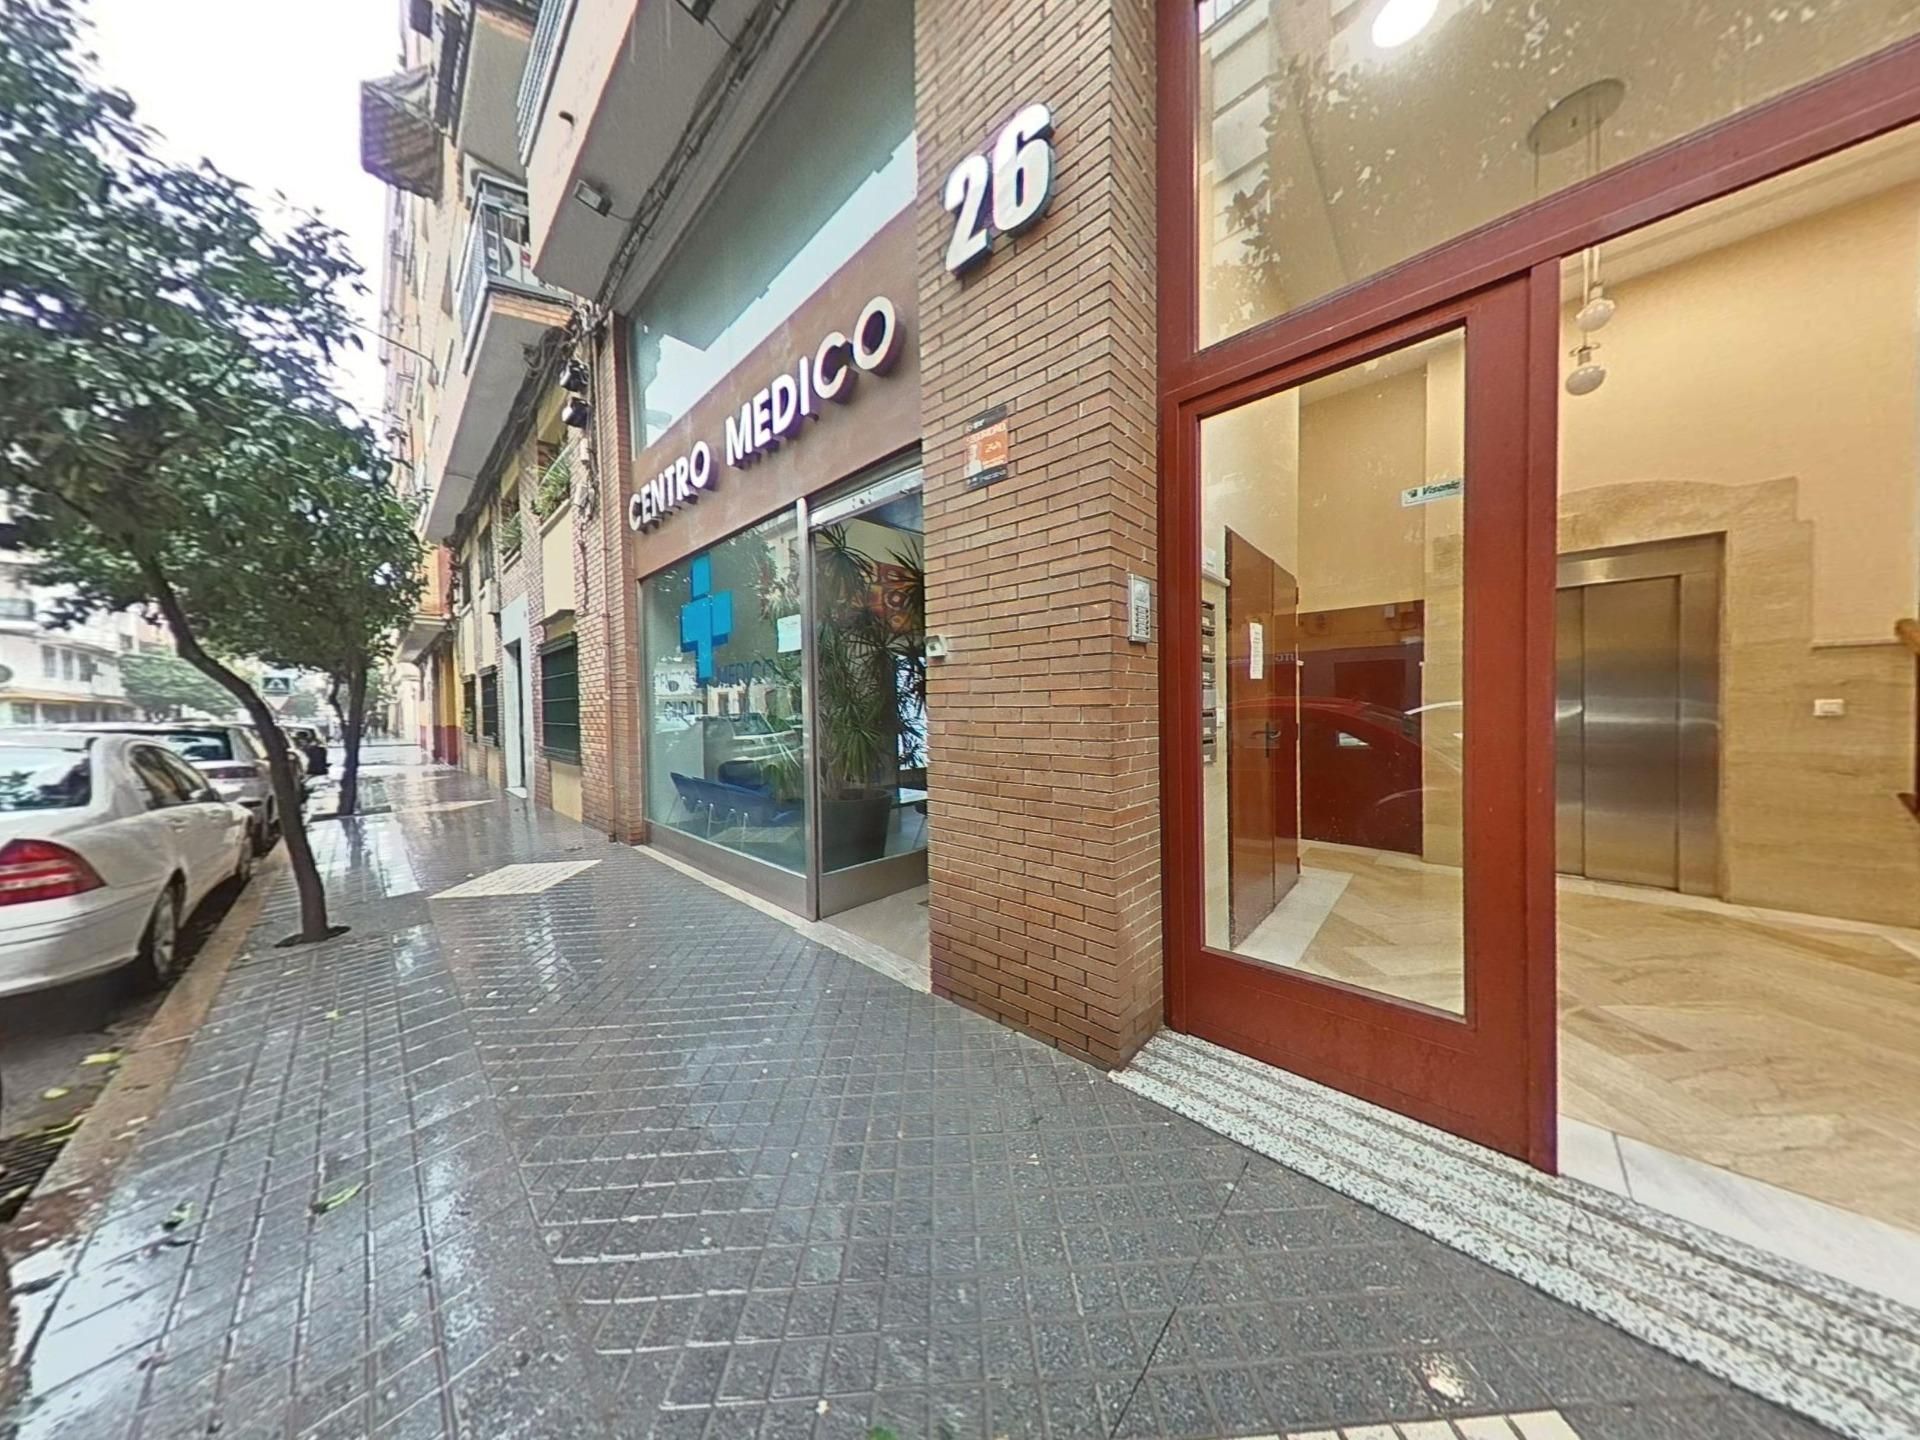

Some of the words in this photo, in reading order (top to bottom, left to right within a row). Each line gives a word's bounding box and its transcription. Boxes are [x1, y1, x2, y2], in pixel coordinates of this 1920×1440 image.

[945, 104, 1052, 273] 26
[629, 441, 712, 532] CENTRO
[725, 296, 897, 467] MEDICO
